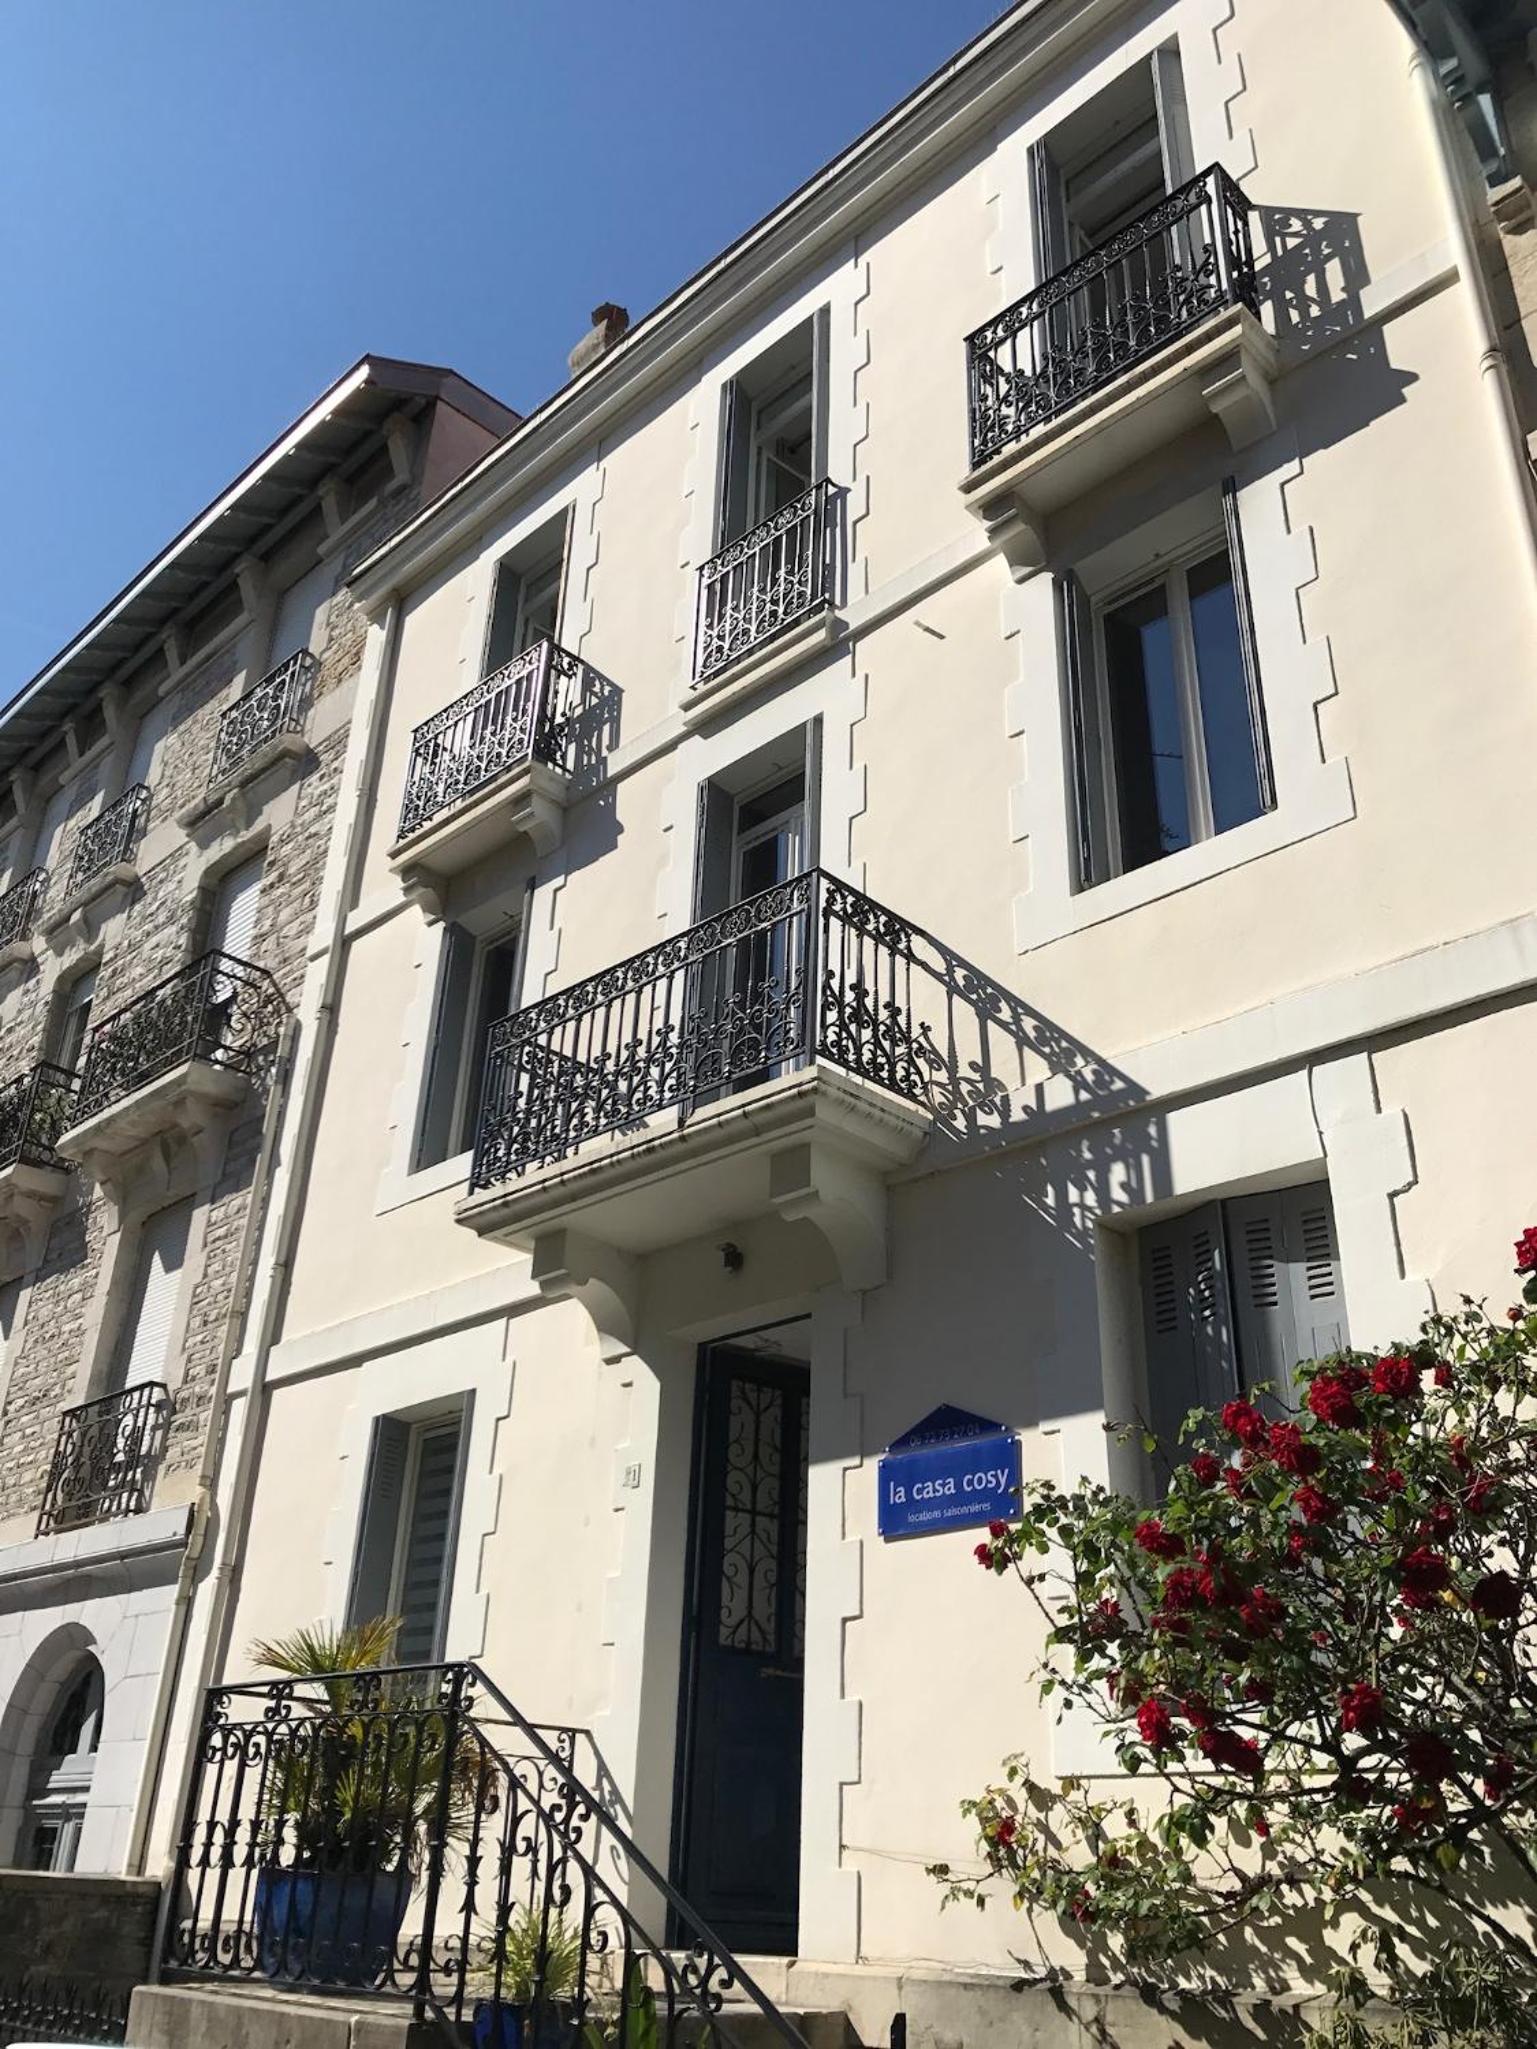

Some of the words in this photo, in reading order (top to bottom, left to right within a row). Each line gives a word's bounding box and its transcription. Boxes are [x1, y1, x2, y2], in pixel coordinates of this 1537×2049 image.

[889, 1481, 906, 1504] la
[912, 1476, 956, 1500] casa
[962, 1467, 1009, 1494] cosy
[907, 1508, 942, 1523] locations
[943, 1502, 991, 1518] saisonnières
